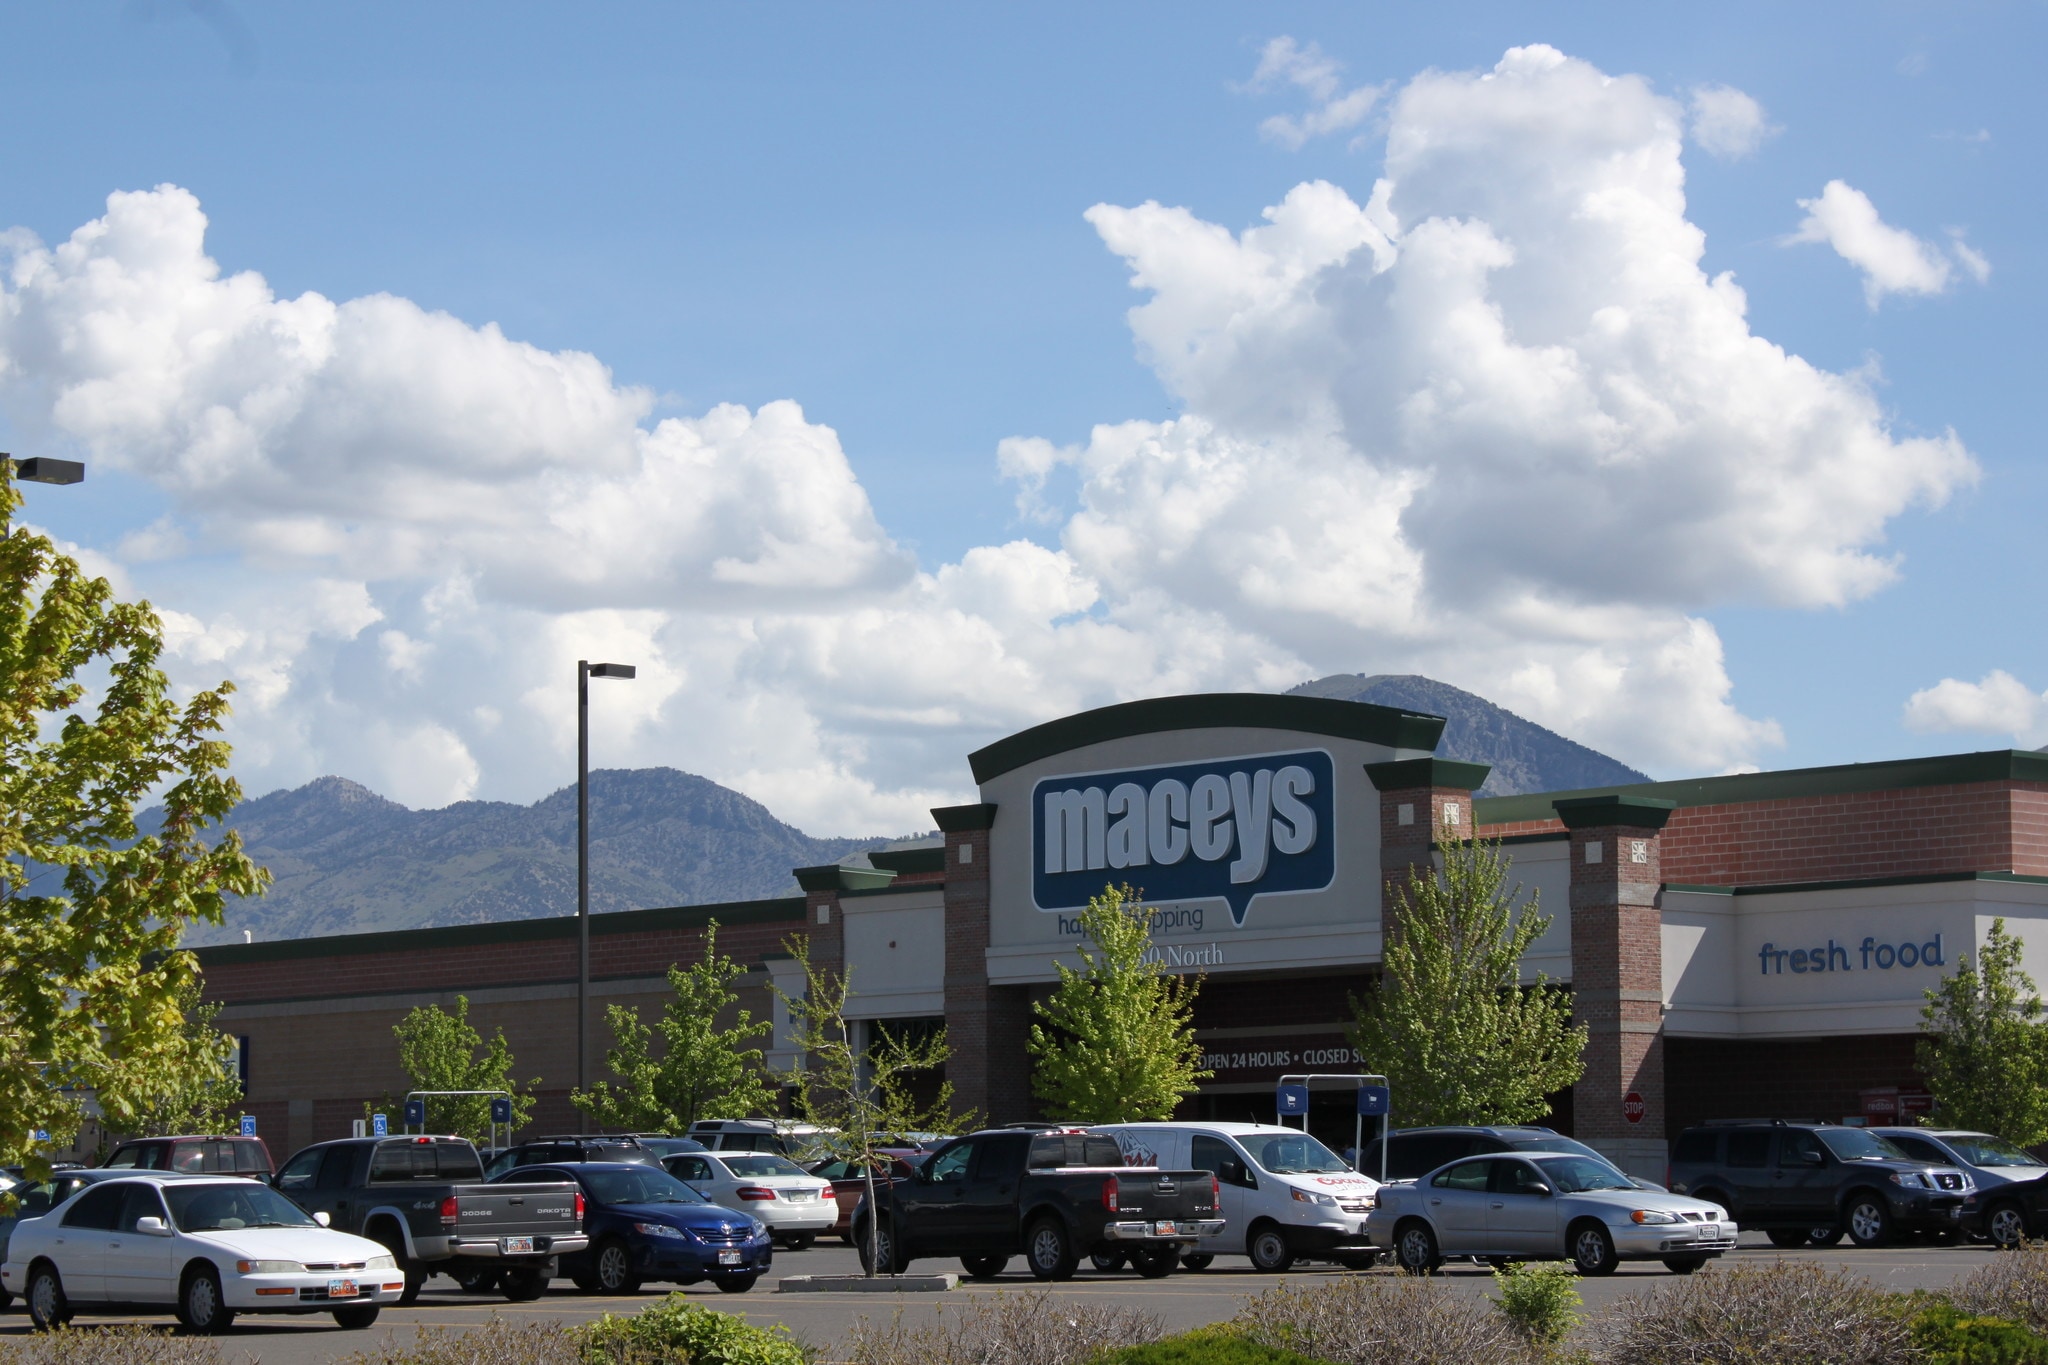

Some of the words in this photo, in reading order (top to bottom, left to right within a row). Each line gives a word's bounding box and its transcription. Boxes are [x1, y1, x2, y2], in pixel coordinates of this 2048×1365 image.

[1045, 765, 1317, 884] maceys
[1167, 943, 1224, 967] North
[1758, 939, 1851, 975] fresh
[1859, 933, 1947, 970] food
[1198, 1054, 1230, 1070] OPEN
[1232, 1053, 1246, 1068] 24
[1248, 1051, 1291, 1067] HOURS
[1303, 1049, 1350, 1065] CLOSED
[1624, 1102, 1643, 1114] STOP
[1867, 1102, 1895, 1111] redbox
